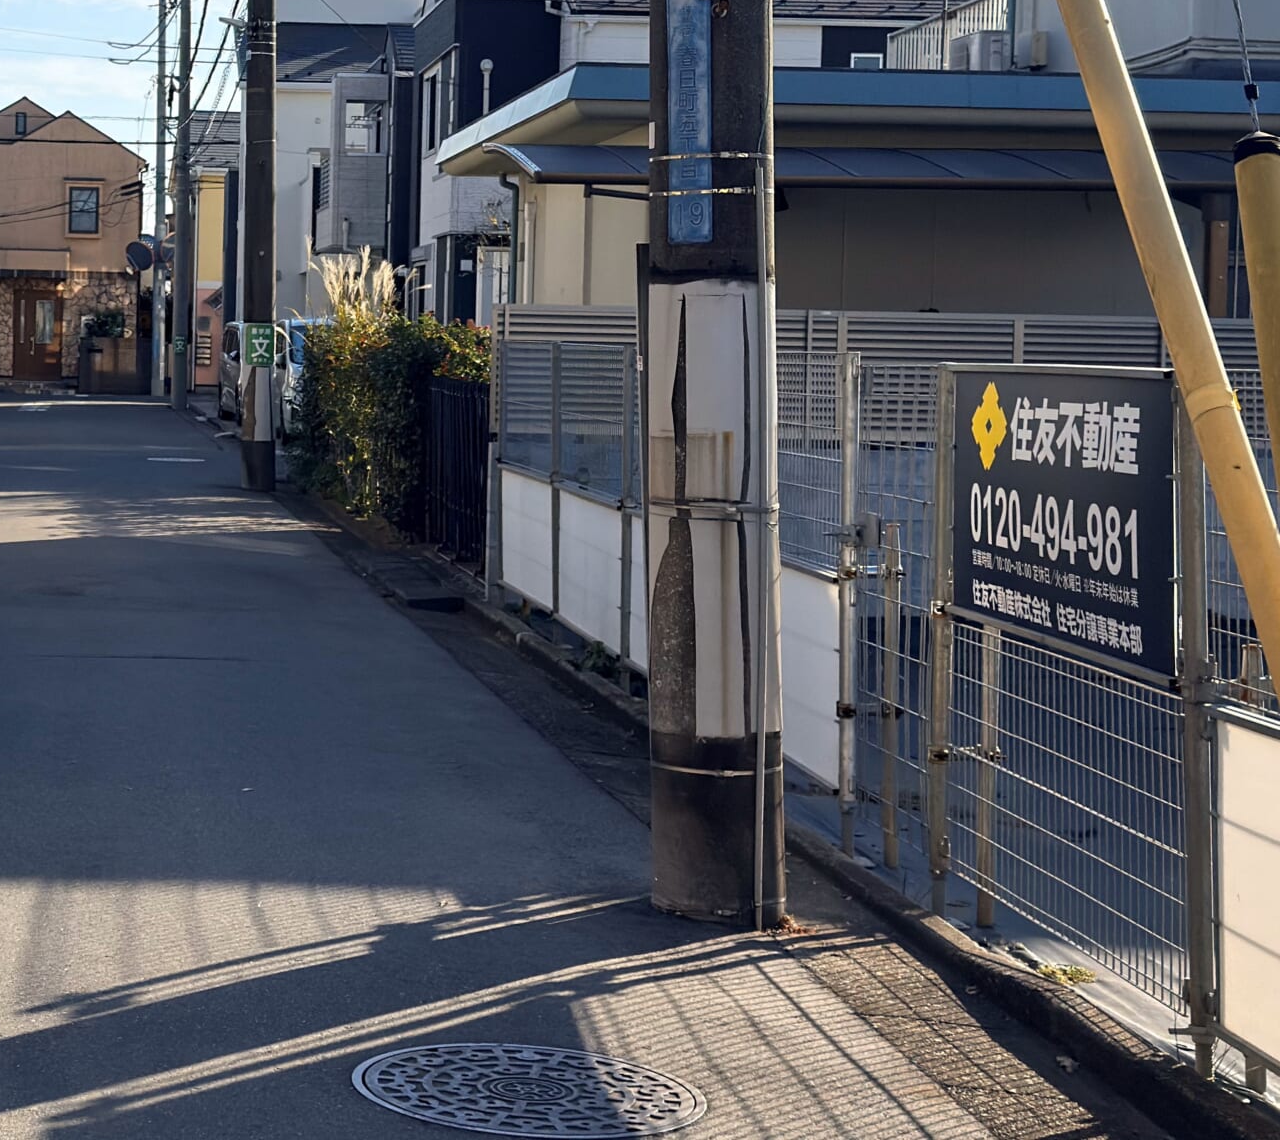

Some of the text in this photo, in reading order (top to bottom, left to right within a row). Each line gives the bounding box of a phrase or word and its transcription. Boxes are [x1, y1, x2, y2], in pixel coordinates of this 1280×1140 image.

[676, 202, 704, 227] 19
[251, 336, 270, 358] 文
[1010, 397, 1140, 475] 住友不動産
[970, 482, 1139, 579] 0120-494-981
[972, 578, 1143, 656] 住友不動産株式会社 住宅分譲事業本部
